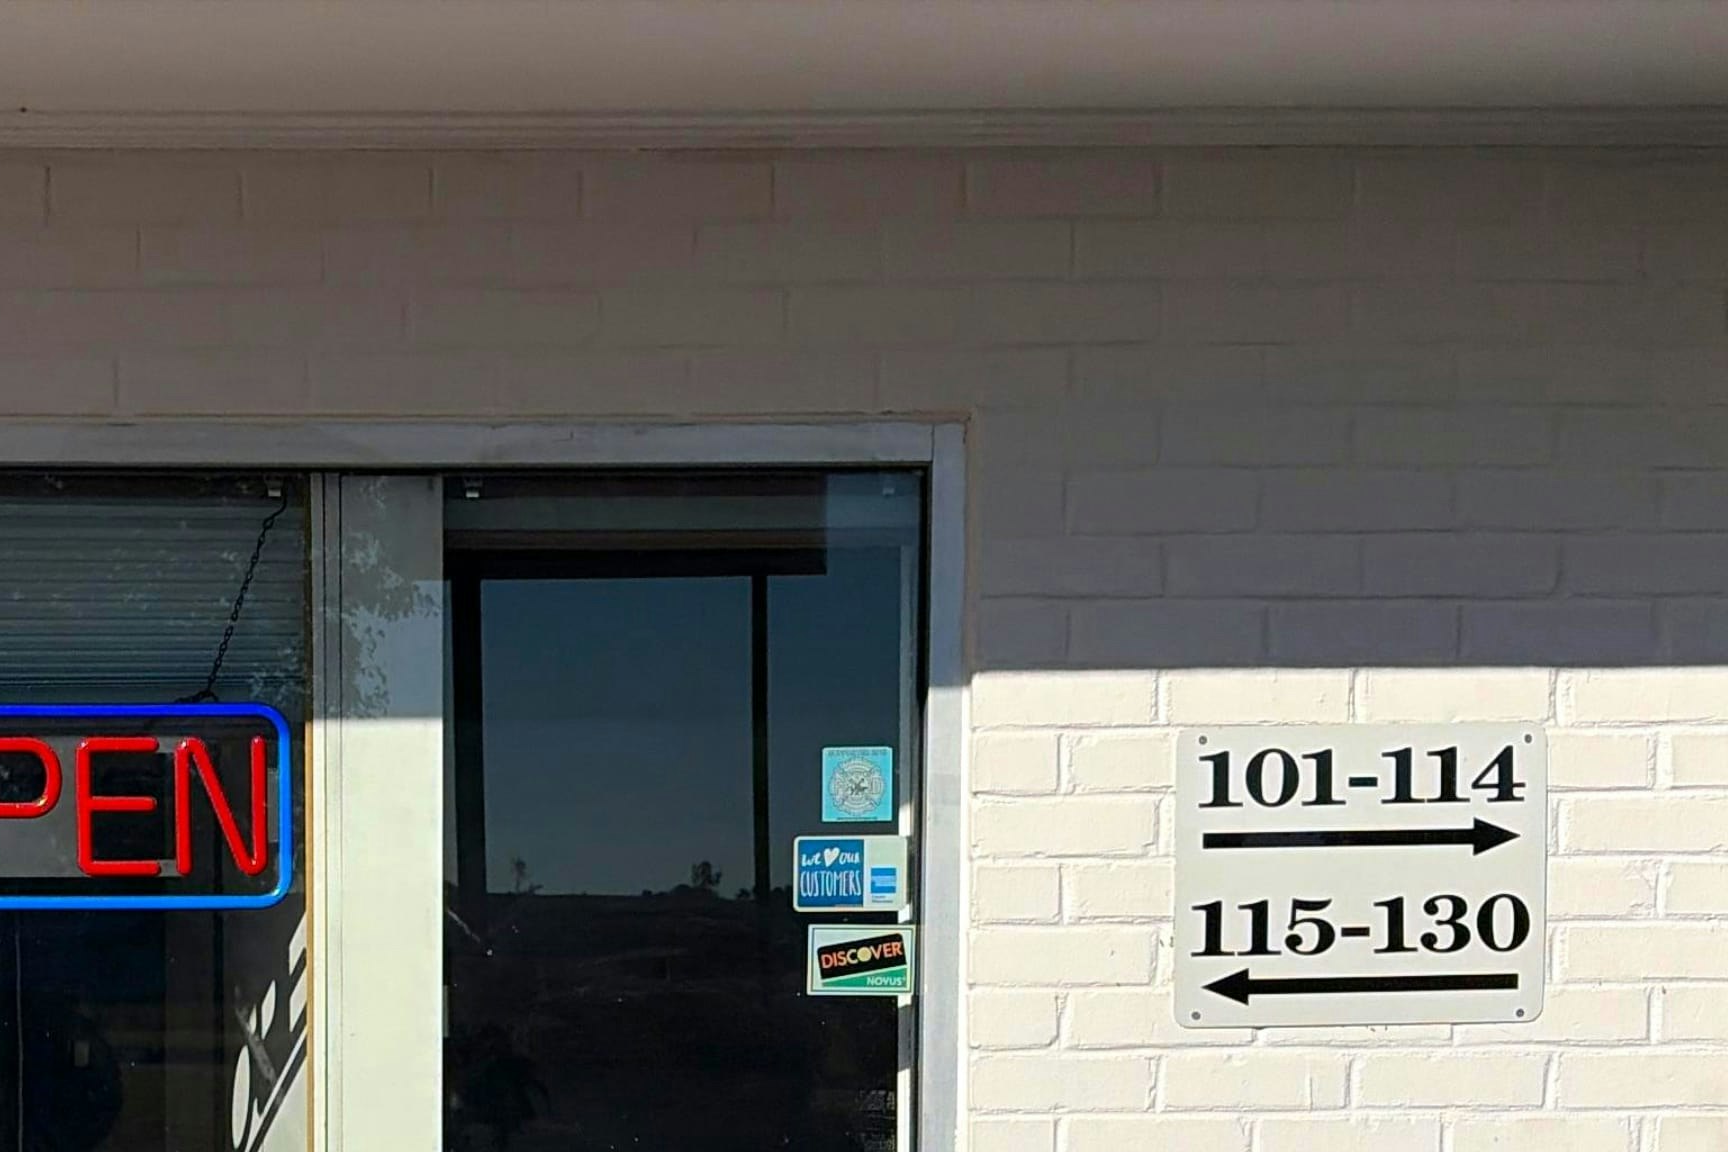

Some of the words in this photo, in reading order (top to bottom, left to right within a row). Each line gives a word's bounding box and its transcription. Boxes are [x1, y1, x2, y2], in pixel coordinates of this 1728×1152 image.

[1198, 745, 1526, 808] 101-114
[800, 870, 861, 897] CUSTOMERS
[1190, 893, 1530, 957] 115-130
[820, 941, 903, 969] DISCOVER
